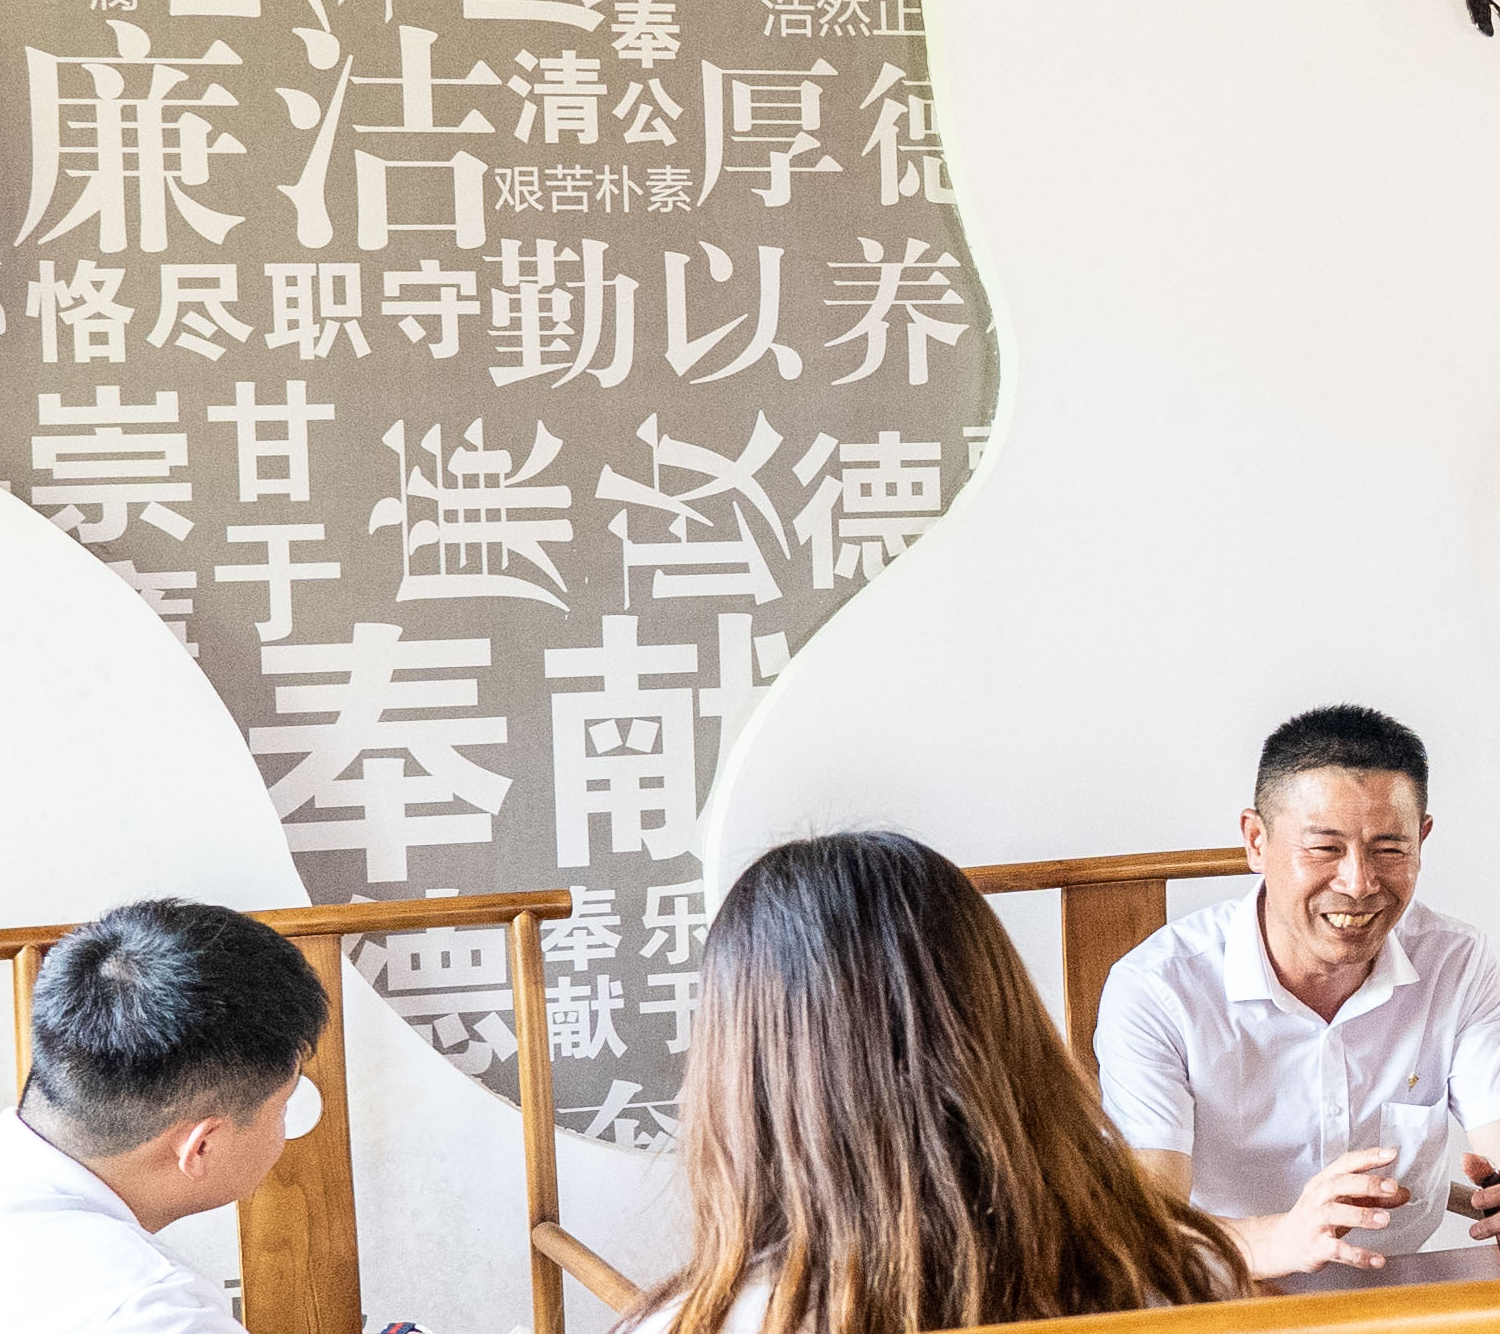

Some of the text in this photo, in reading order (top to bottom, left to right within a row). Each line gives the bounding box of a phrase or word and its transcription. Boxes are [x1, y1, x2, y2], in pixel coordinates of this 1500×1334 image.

[14, 20, 502, 253] 廉洁
[509, 49, 608, 145] 清
[494, 164, 693, 215] 艰苦朴素
[26, 259, 481, 364] 恪尽职守
[483, 238, 997, 388] 勤以养
[30, 385, 196, 545] 崇
[207, 379, 341, 642] 甘于
